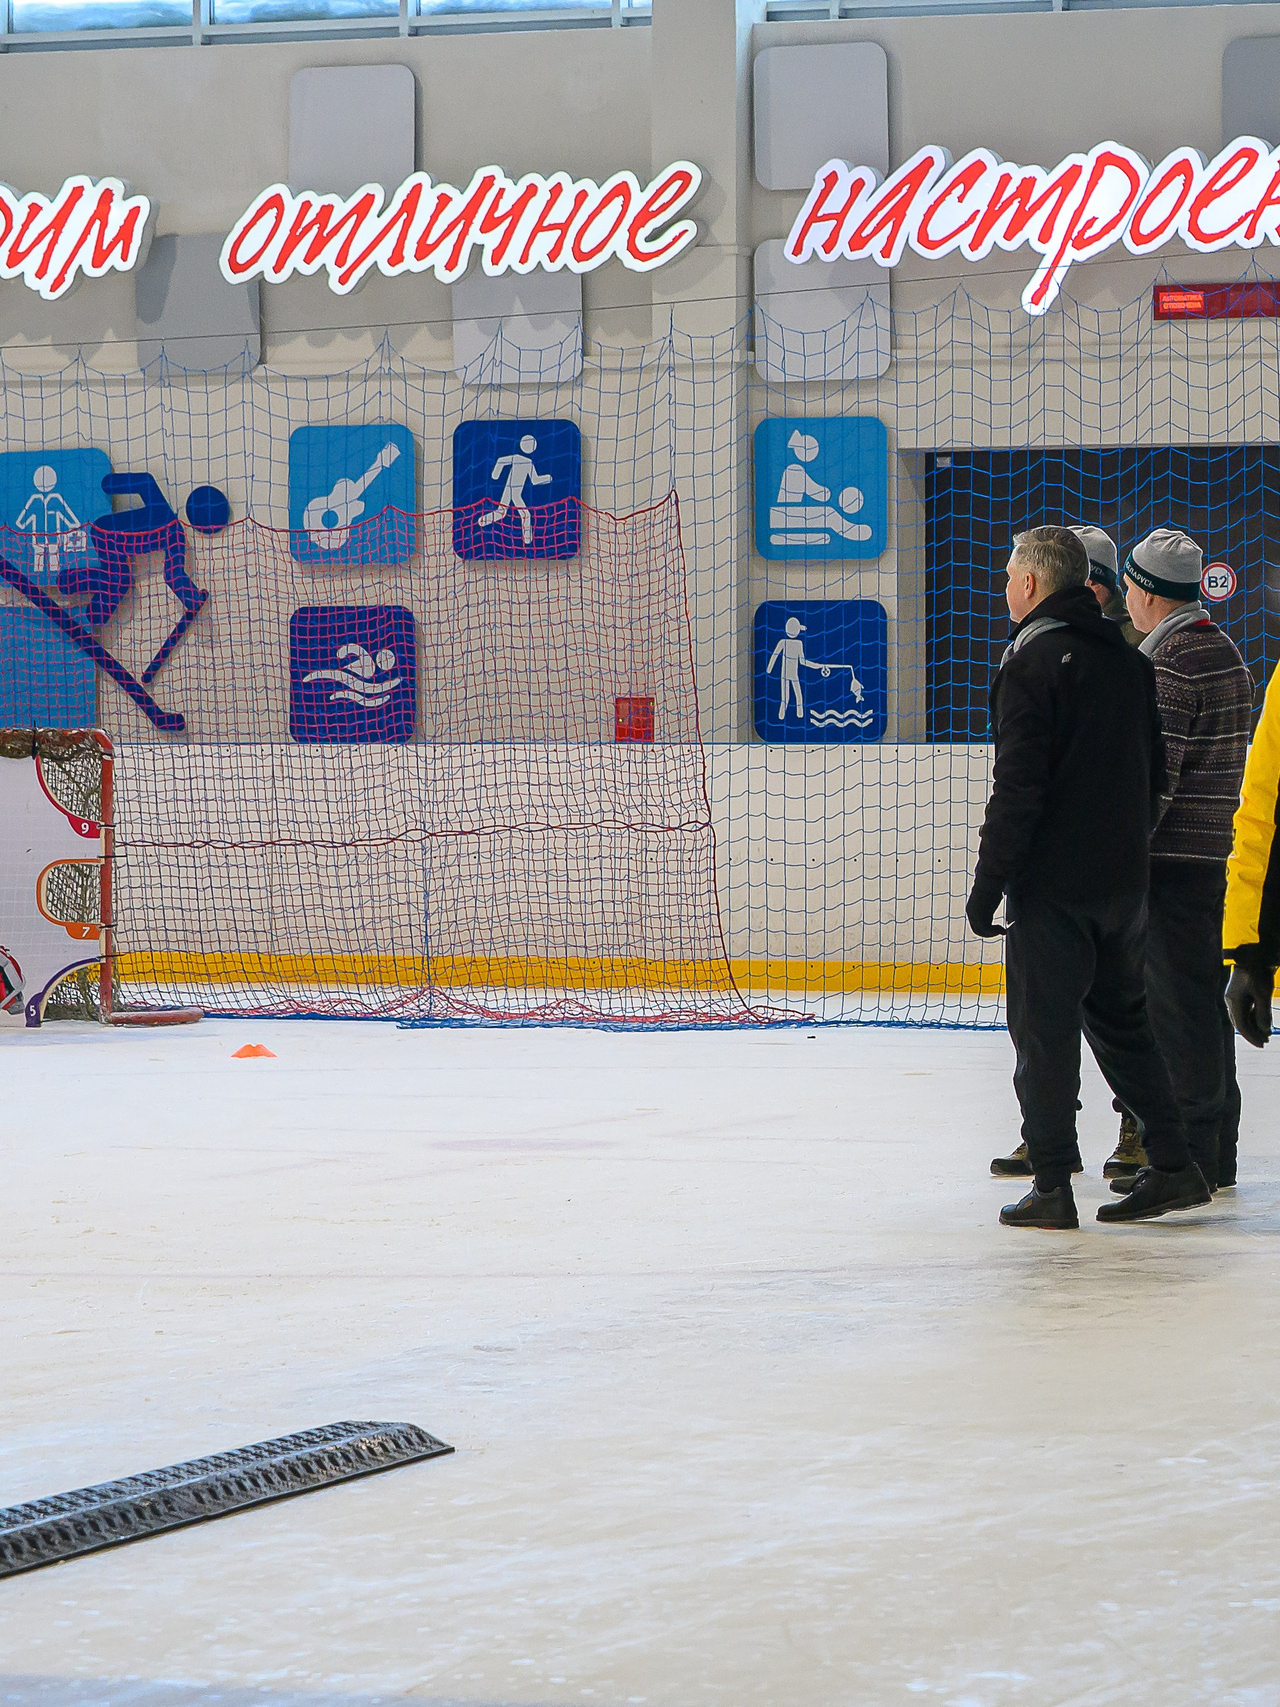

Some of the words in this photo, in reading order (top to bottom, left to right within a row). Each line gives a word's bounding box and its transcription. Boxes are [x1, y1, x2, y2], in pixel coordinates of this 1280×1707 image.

[0, 185, 141, 293] им
[227, 170, 693, 286] отличное
[81, 822, 90, 834] 9
[82, 926, 91, 938] 7
[29, 1005, 37, 1017] 5
